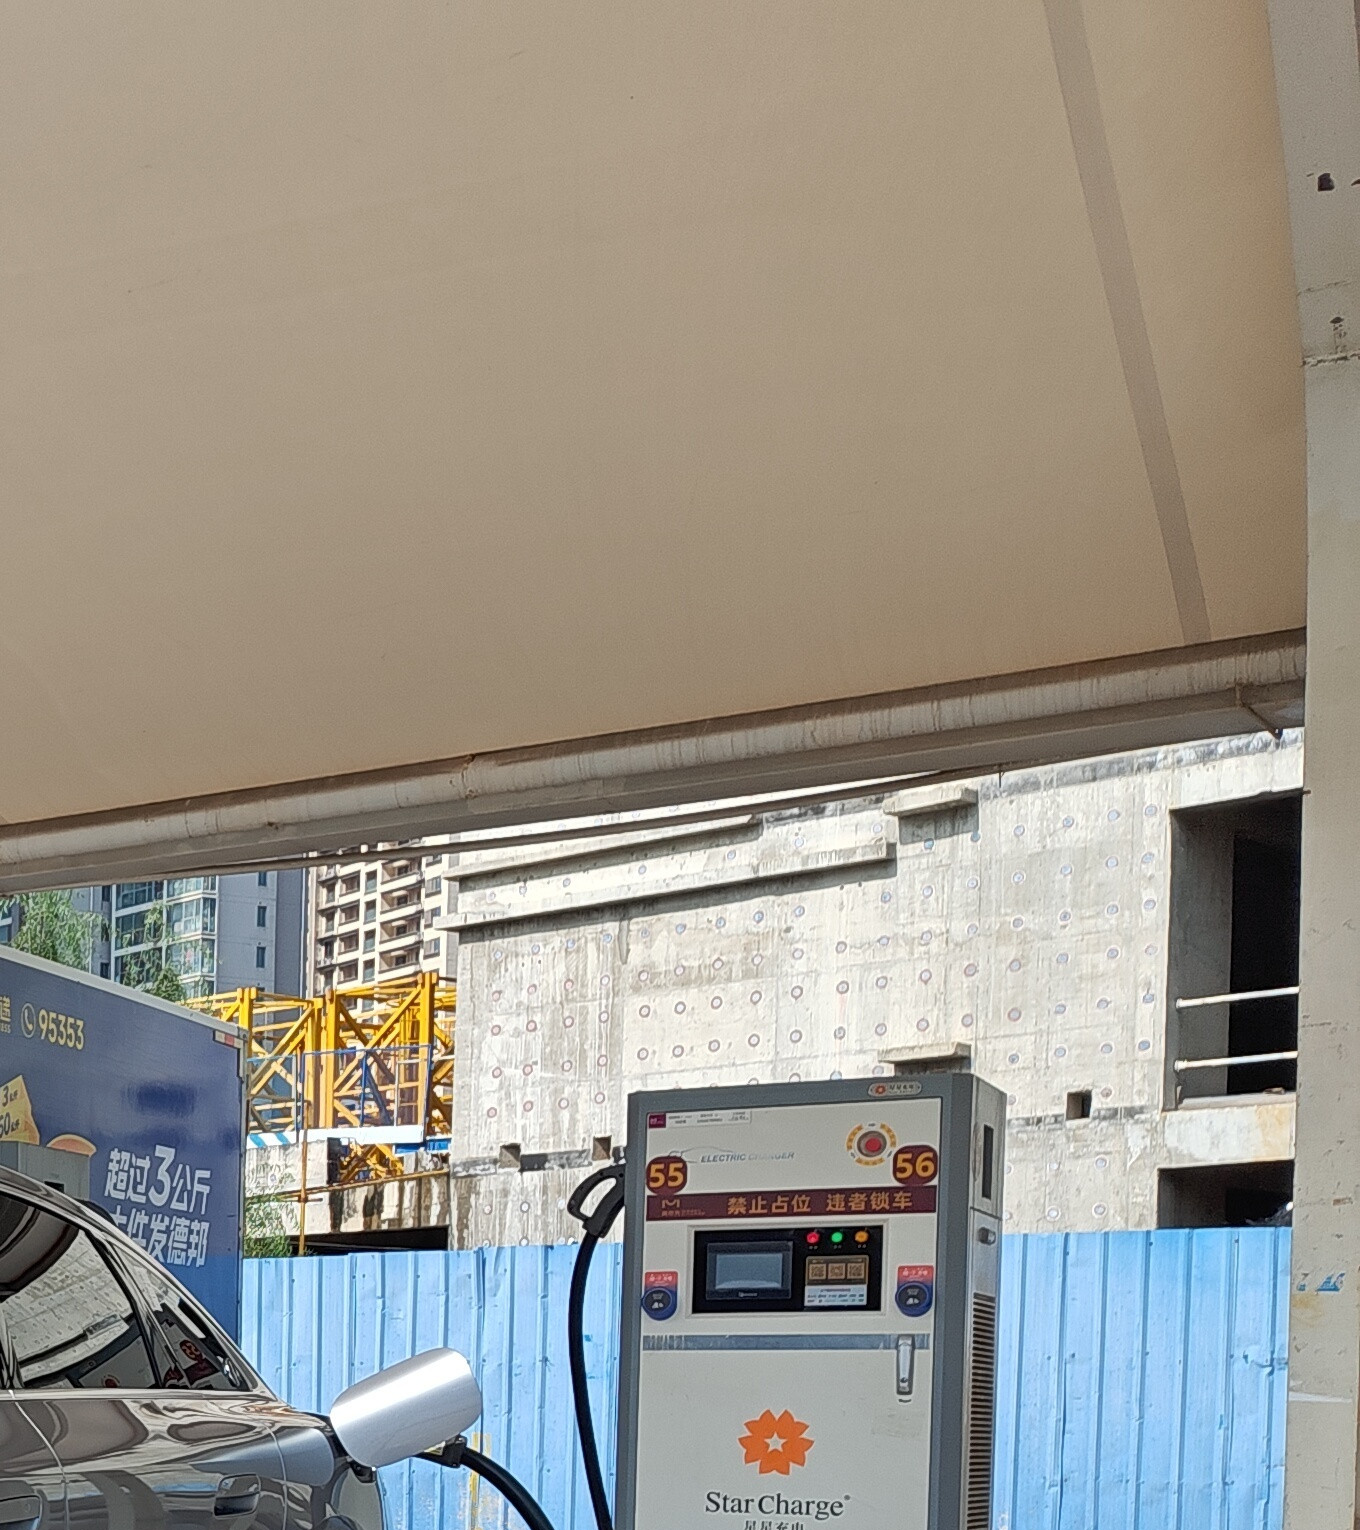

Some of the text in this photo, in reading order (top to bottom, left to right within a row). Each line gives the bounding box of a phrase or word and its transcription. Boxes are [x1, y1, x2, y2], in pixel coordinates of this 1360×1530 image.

[38, 1008, 85, 1050] 95353
[700, 1152, 746, 1164] ELECTRIC
[895, 1152, 935, 1178] 56
[104, 1144, 212, 1215] 超过3公斤
[649, 1162, 684, 1188] 55
[727, 1190, 913, 1215] 禁止占位 违者锁车
